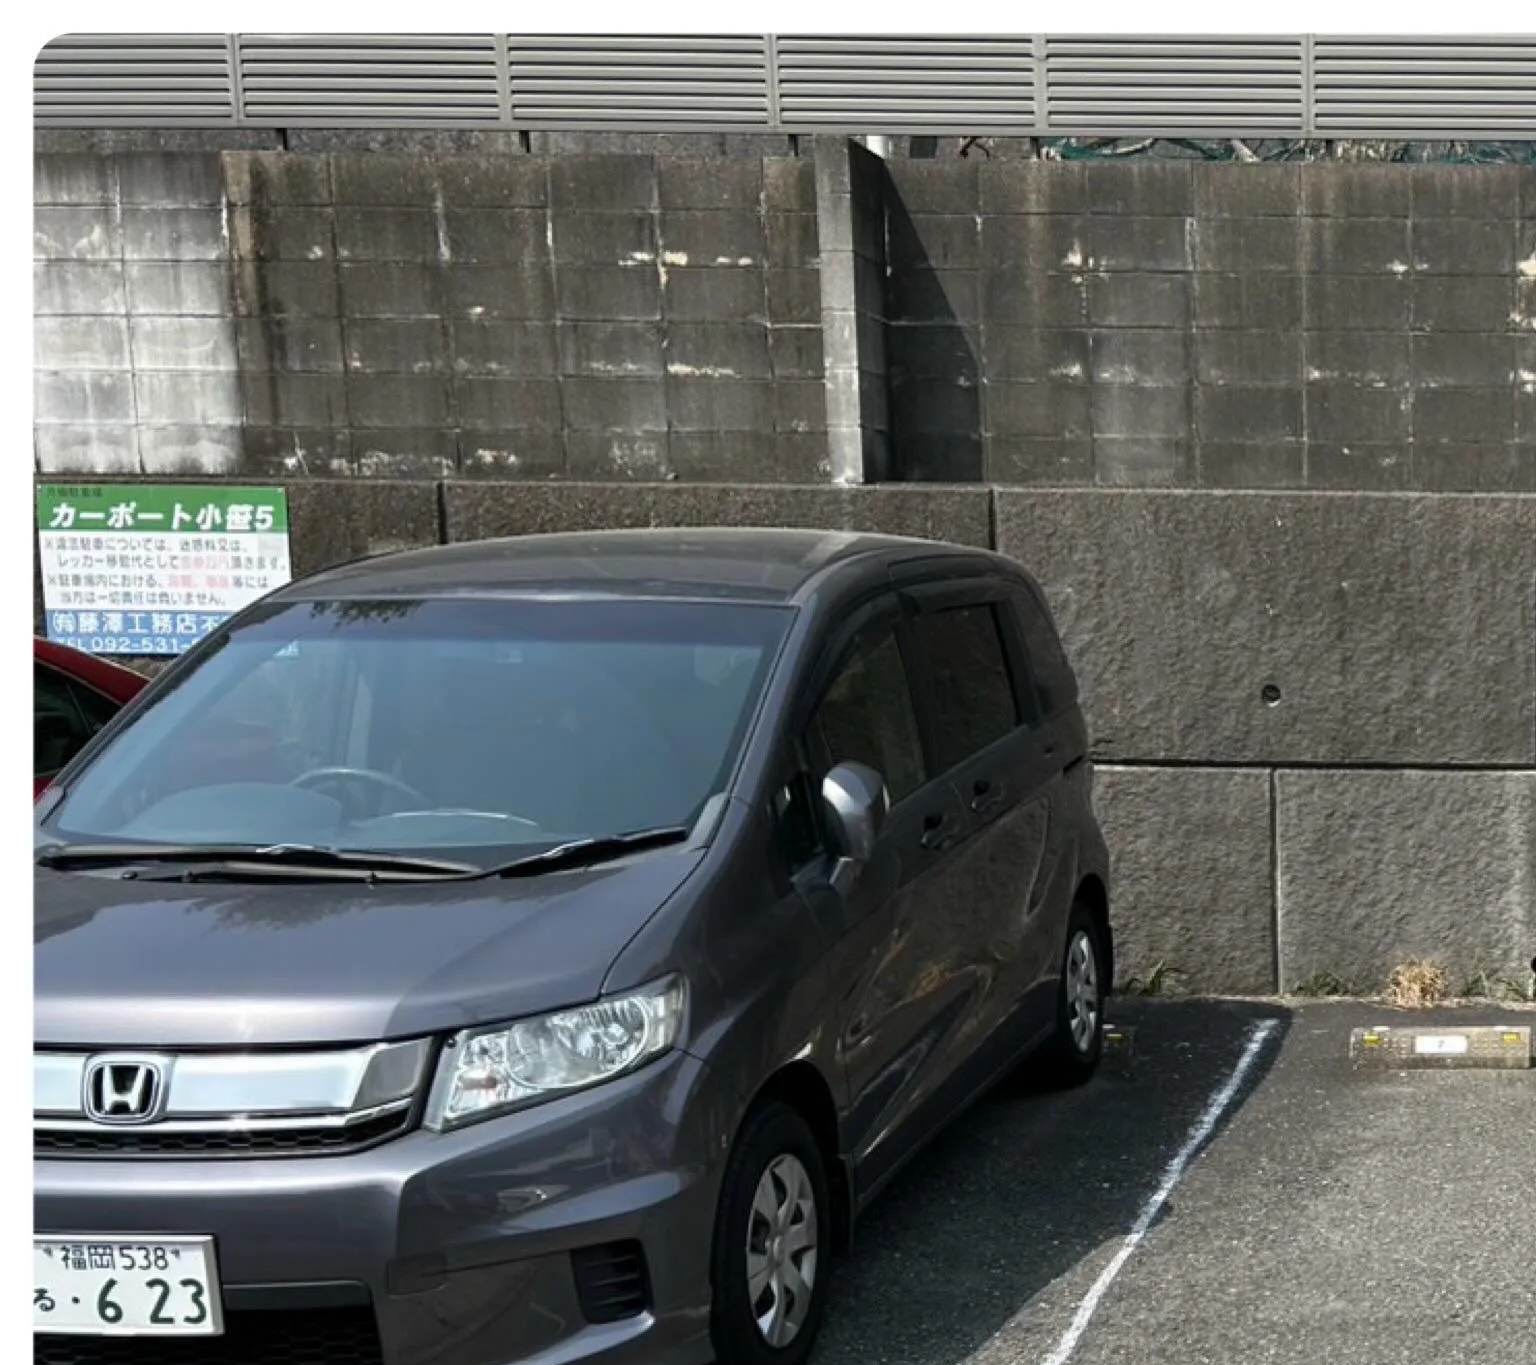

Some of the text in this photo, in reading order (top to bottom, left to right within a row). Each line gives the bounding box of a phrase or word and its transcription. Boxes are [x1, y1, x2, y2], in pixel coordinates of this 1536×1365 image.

[49, 502, 275, 530] カーポート小笹5
